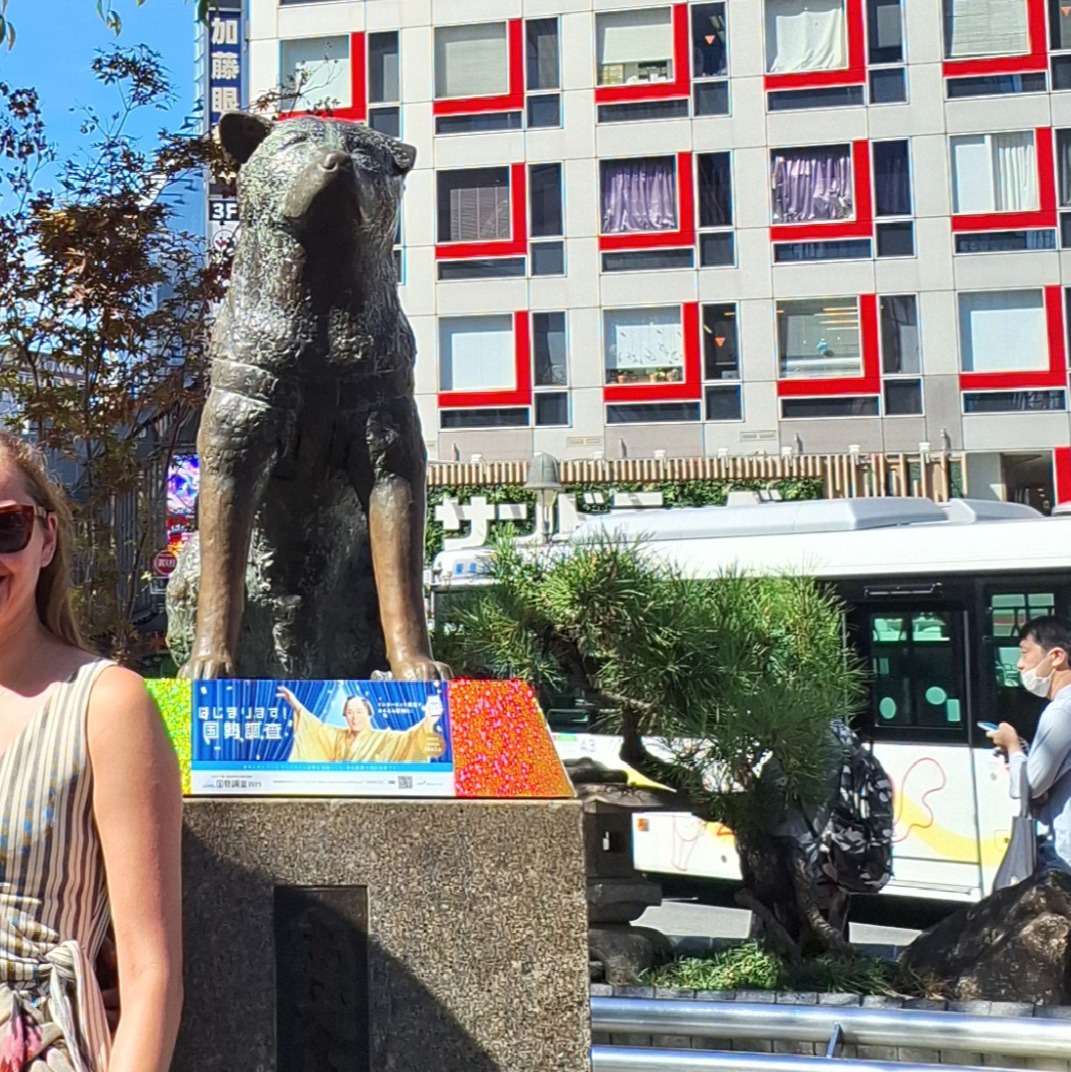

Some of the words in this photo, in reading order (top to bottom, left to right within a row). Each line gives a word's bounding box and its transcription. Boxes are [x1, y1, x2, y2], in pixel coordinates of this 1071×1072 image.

[211, 17, 240, 140] 加藤眼
[212, 203, 237, 219] 3F
